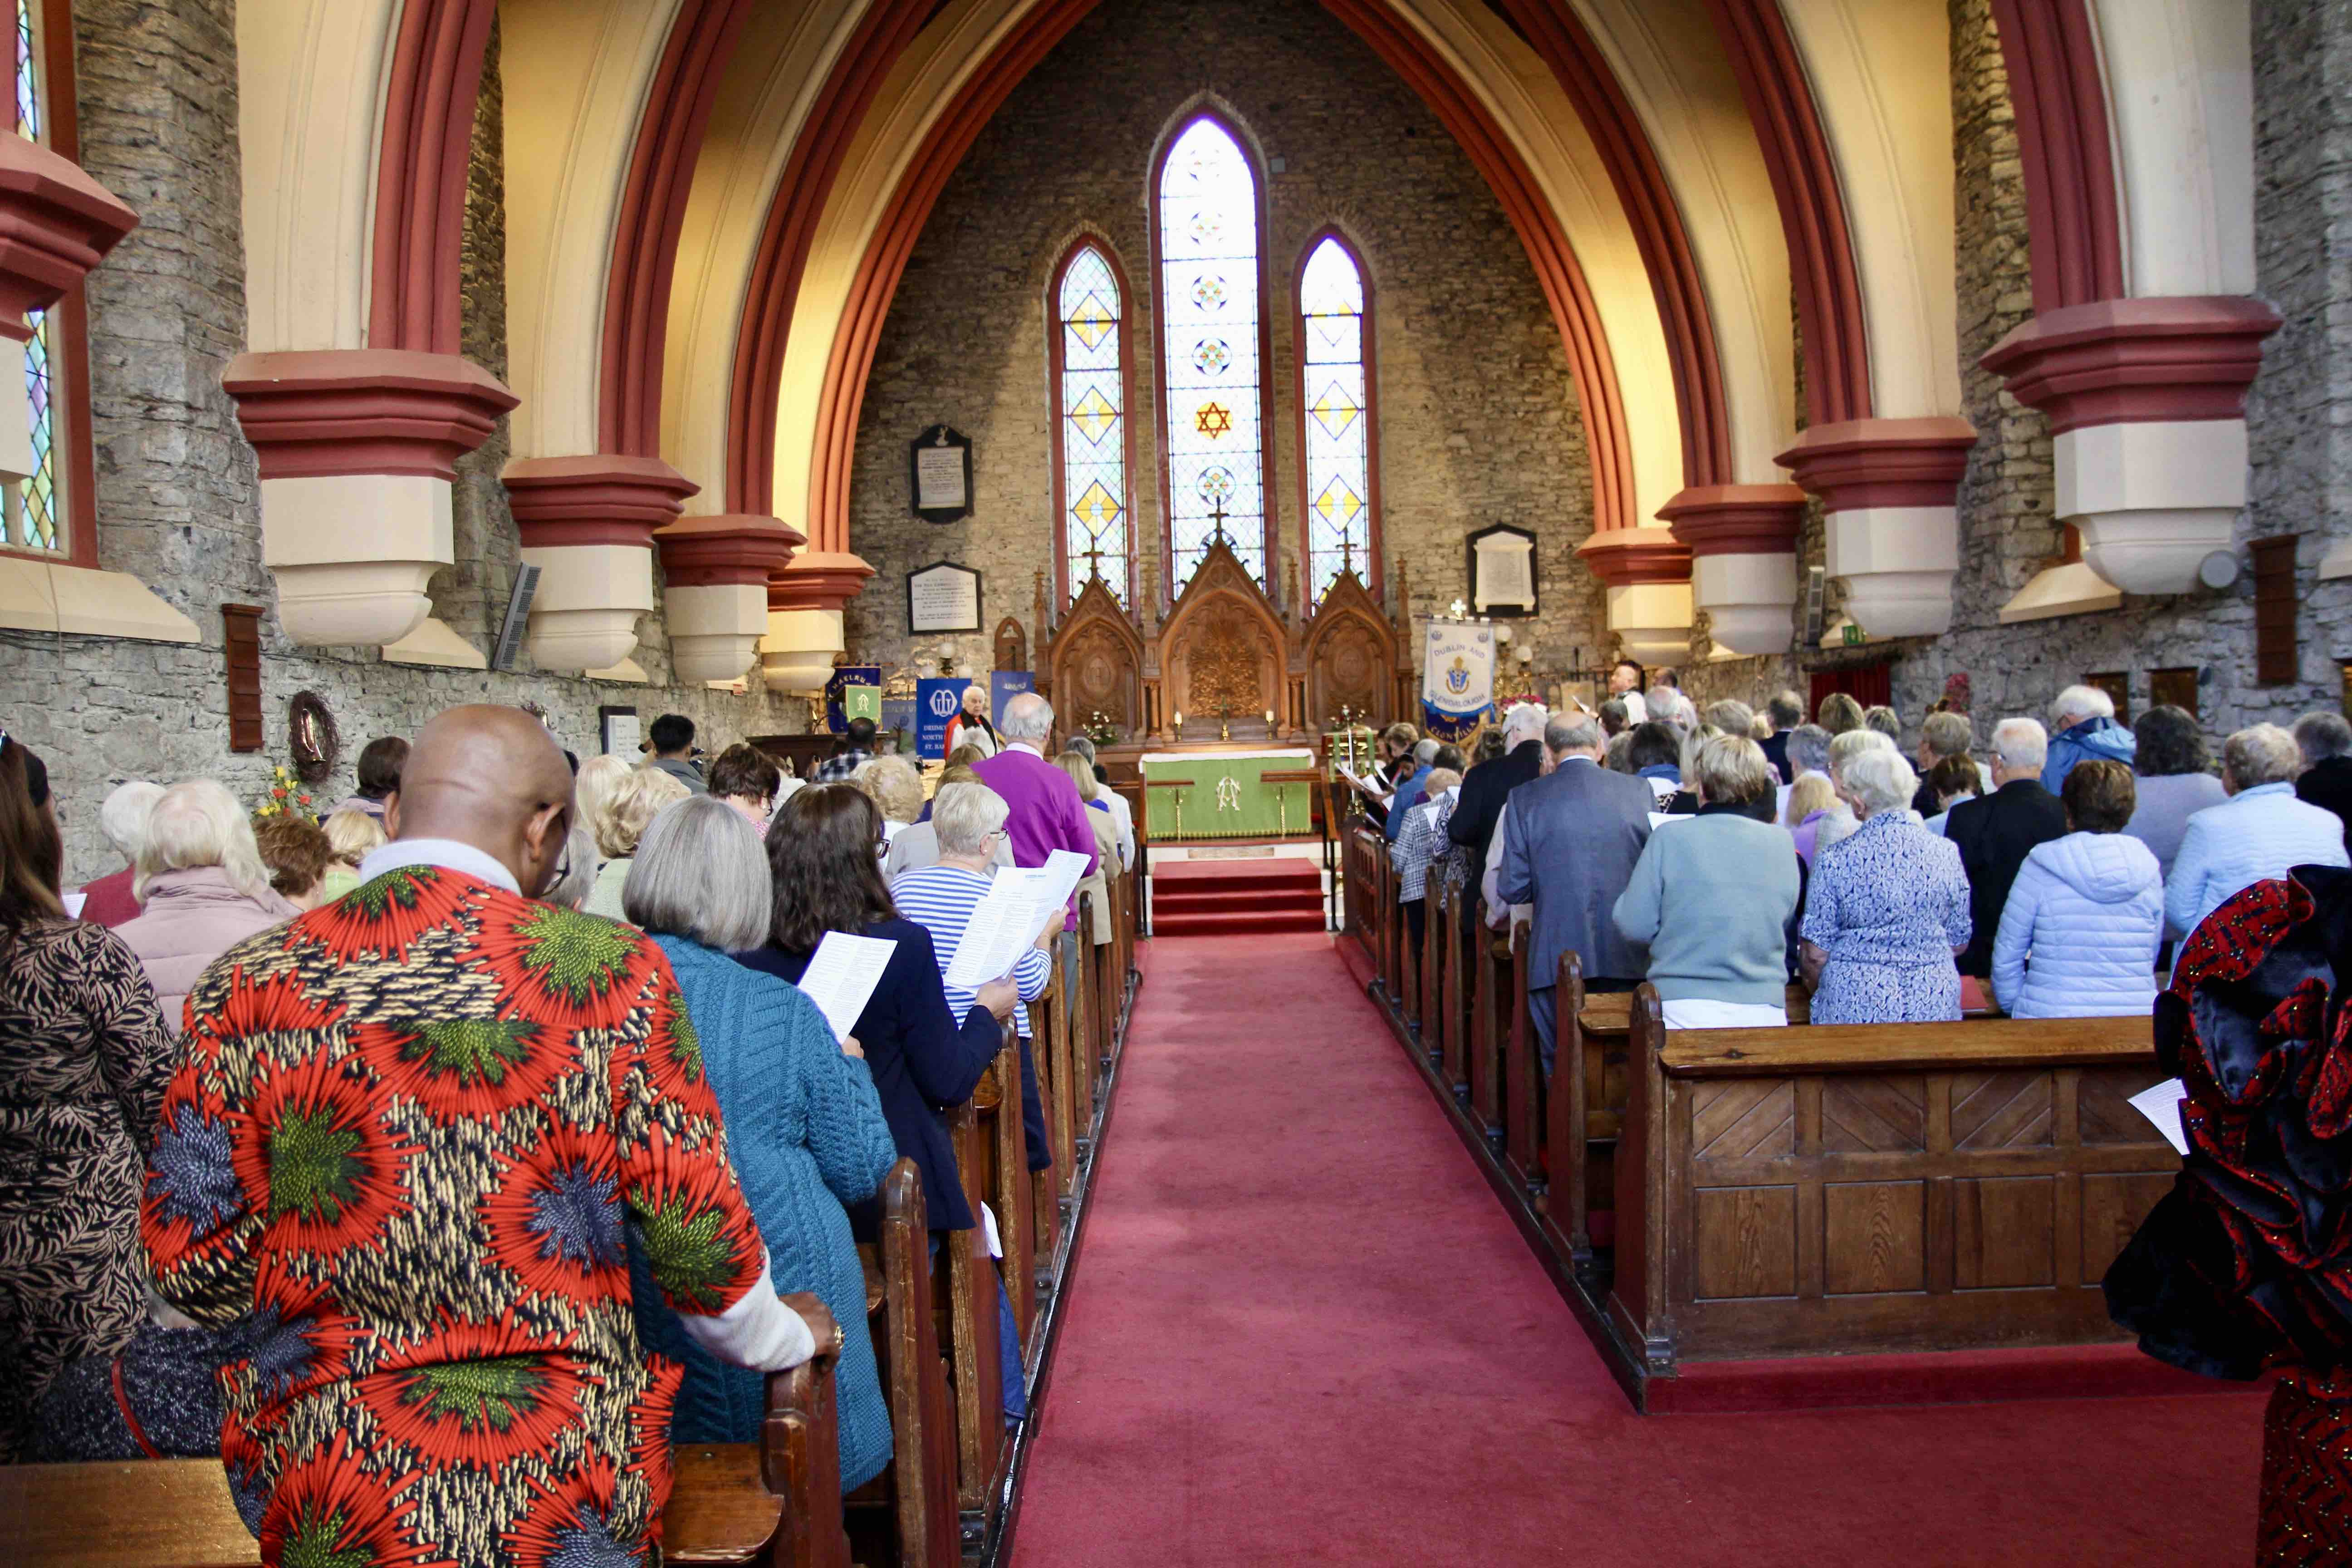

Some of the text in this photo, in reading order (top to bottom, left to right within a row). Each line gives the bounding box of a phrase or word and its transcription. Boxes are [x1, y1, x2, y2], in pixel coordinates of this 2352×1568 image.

[1434, 644, 1485, 659] DUBLIN AND
[1430, 691, 1485, 708] GLENDALOUGH
[1431, 721, 1477, 740] CLONILLA
